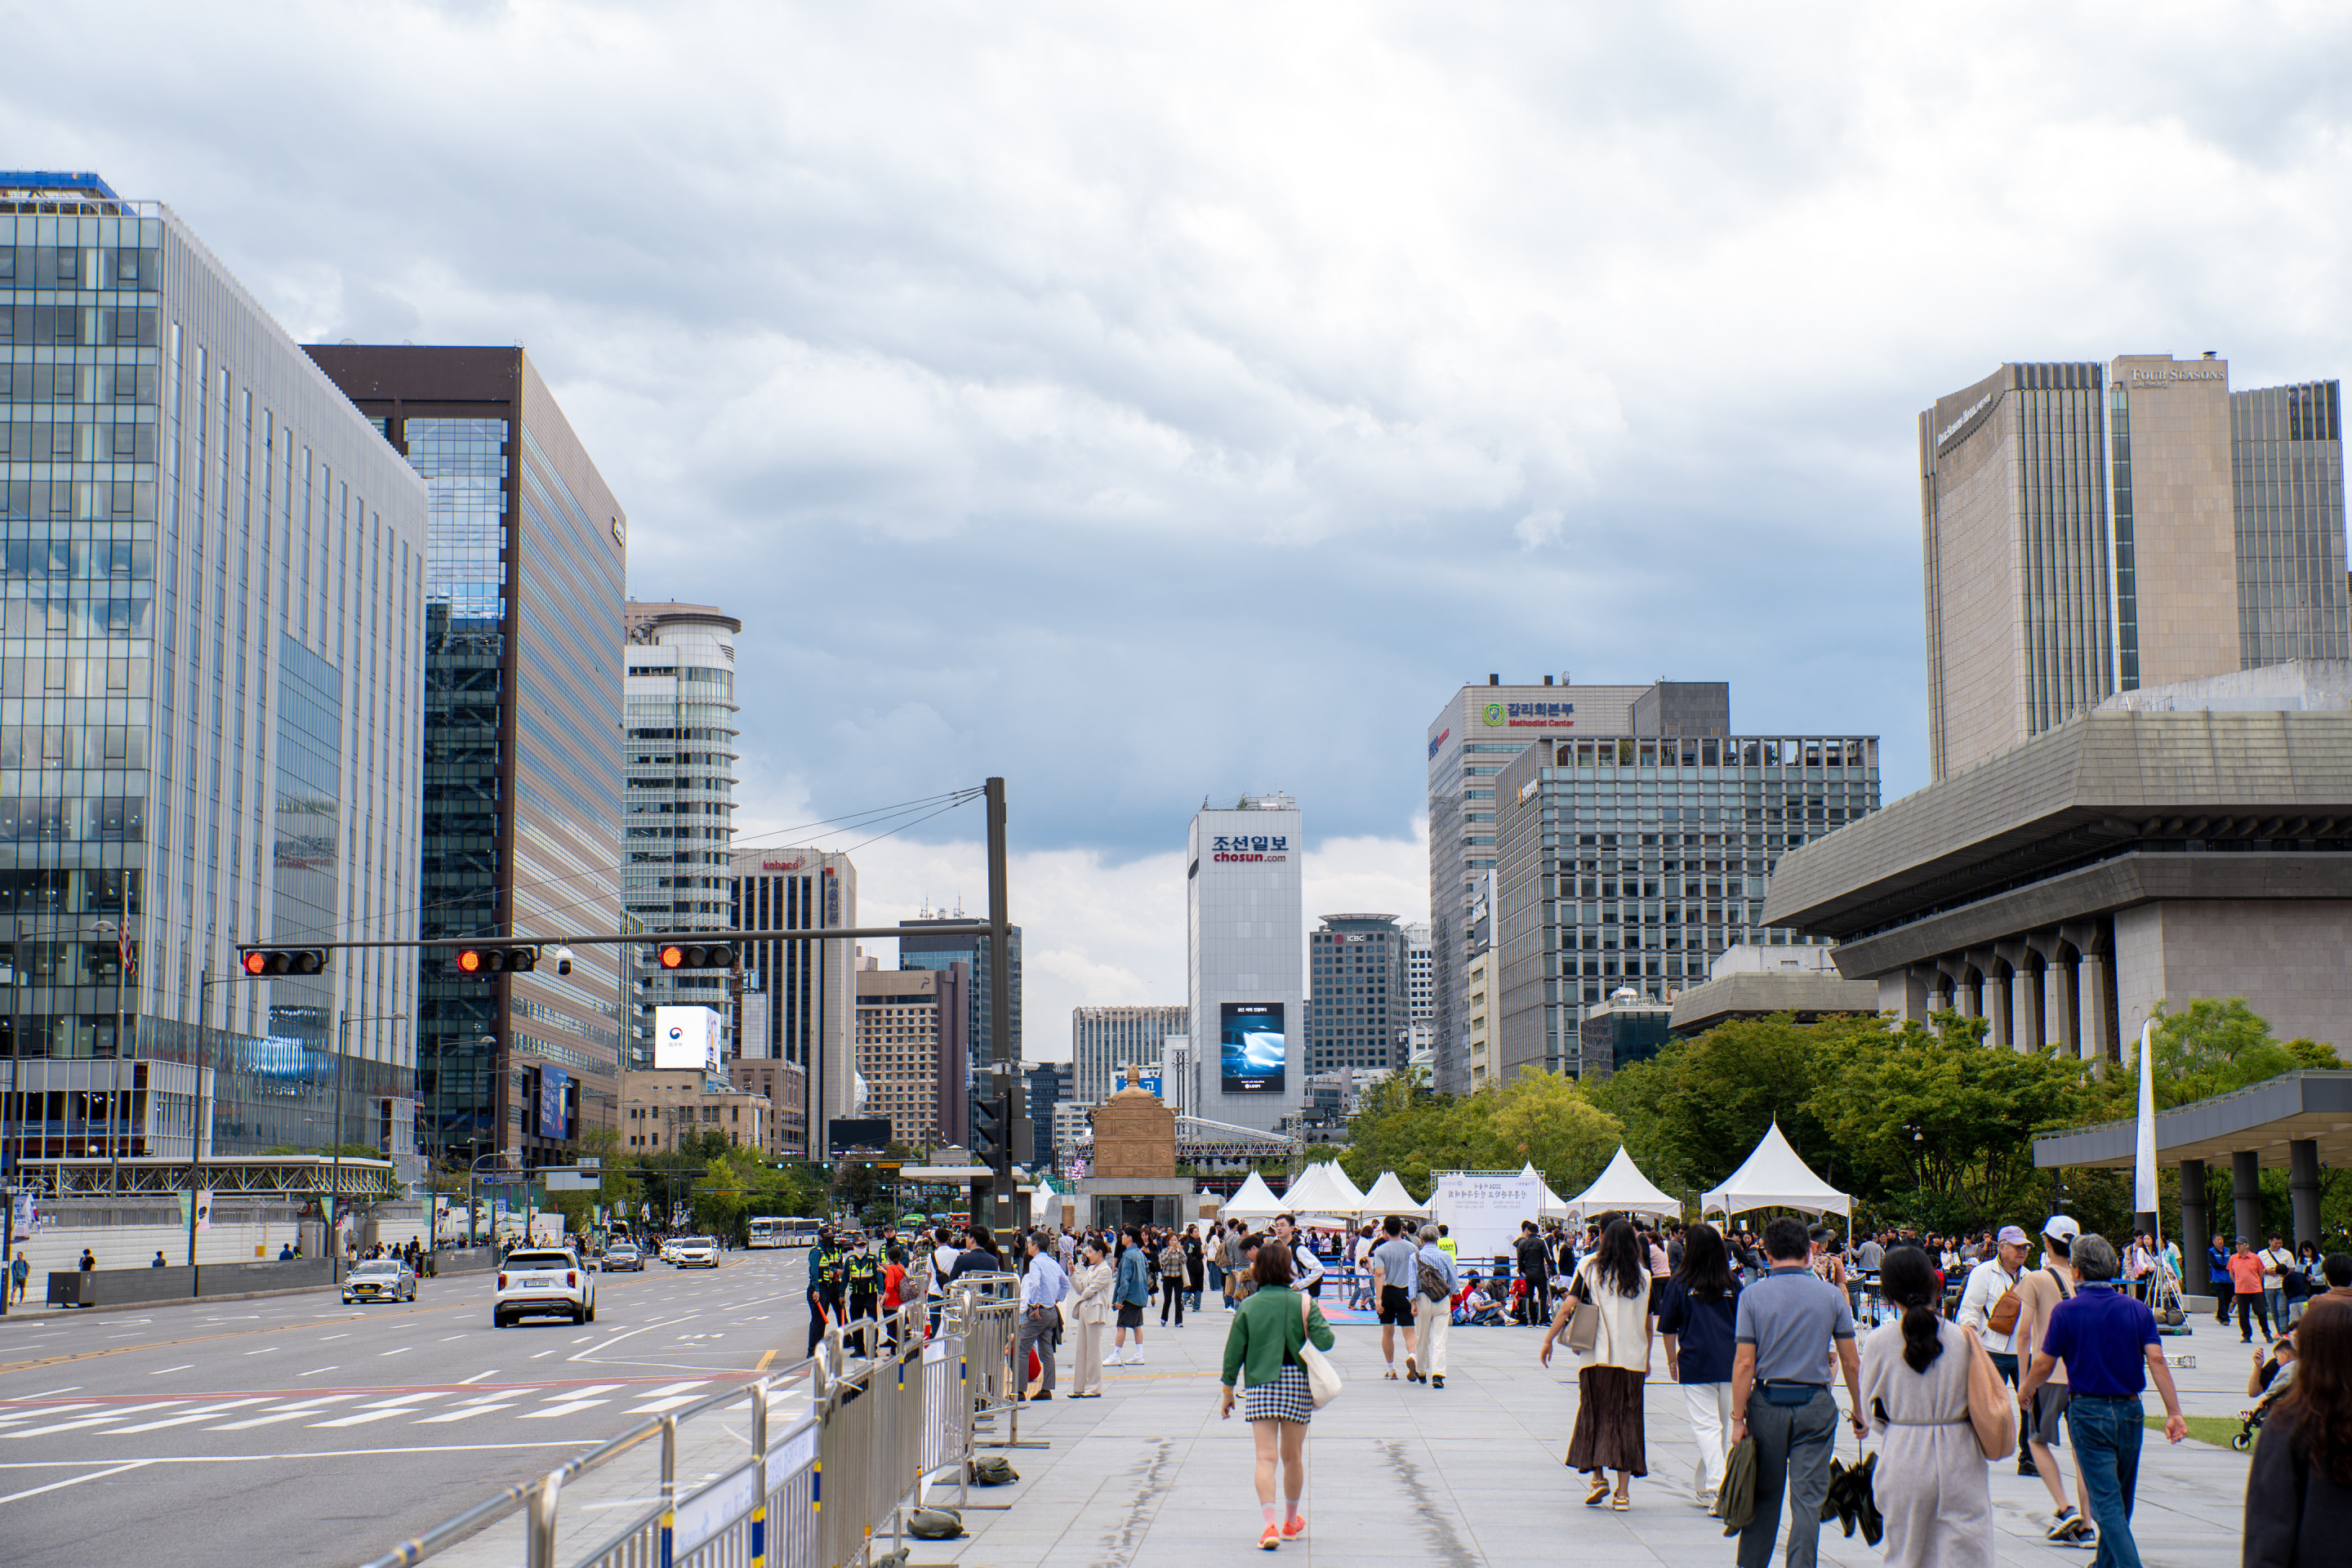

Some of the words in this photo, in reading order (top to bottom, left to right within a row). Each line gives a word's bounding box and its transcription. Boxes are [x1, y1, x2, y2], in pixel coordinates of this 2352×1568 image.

[2169, 368, 2225, 381] SEASONS
[1508, 702, 1575, 717] 감리회본부
[1212, 835, 1290, 851] 조선일보
[1214, 852, 1286, 862] chosun.com
[763, 860, 799, 870] kobaco
